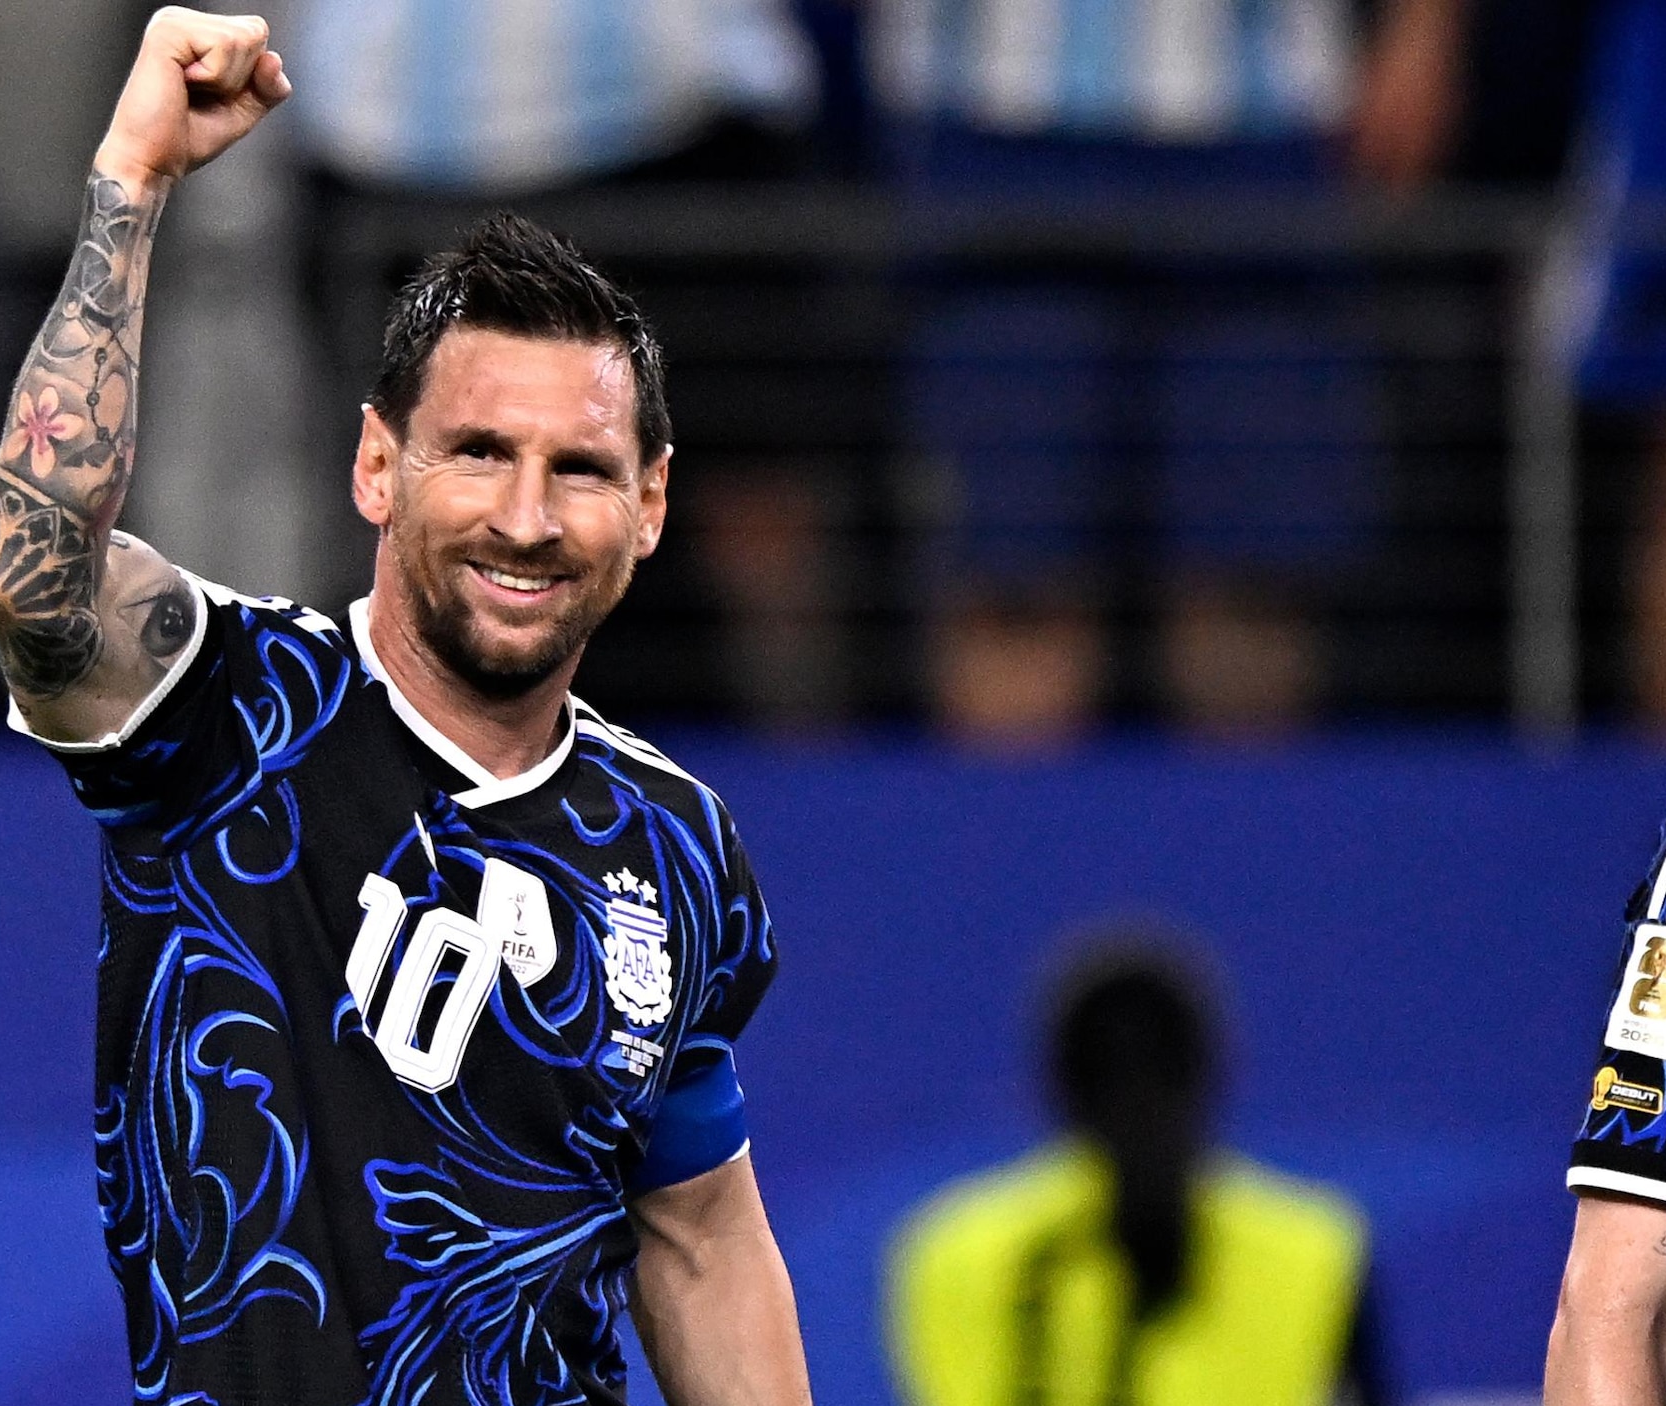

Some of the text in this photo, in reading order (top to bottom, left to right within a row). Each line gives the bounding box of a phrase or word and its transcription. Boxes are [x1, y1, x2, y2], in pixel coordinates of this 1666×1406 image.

[501, 940, 536, 960] FIFA
[621, 933, 658, 990] AFA
[345, 872, 501, 1094] 10
[1621, 1028, 1664, 1046] 202
[1611, 1084, 1657, 1102] DEBUT
